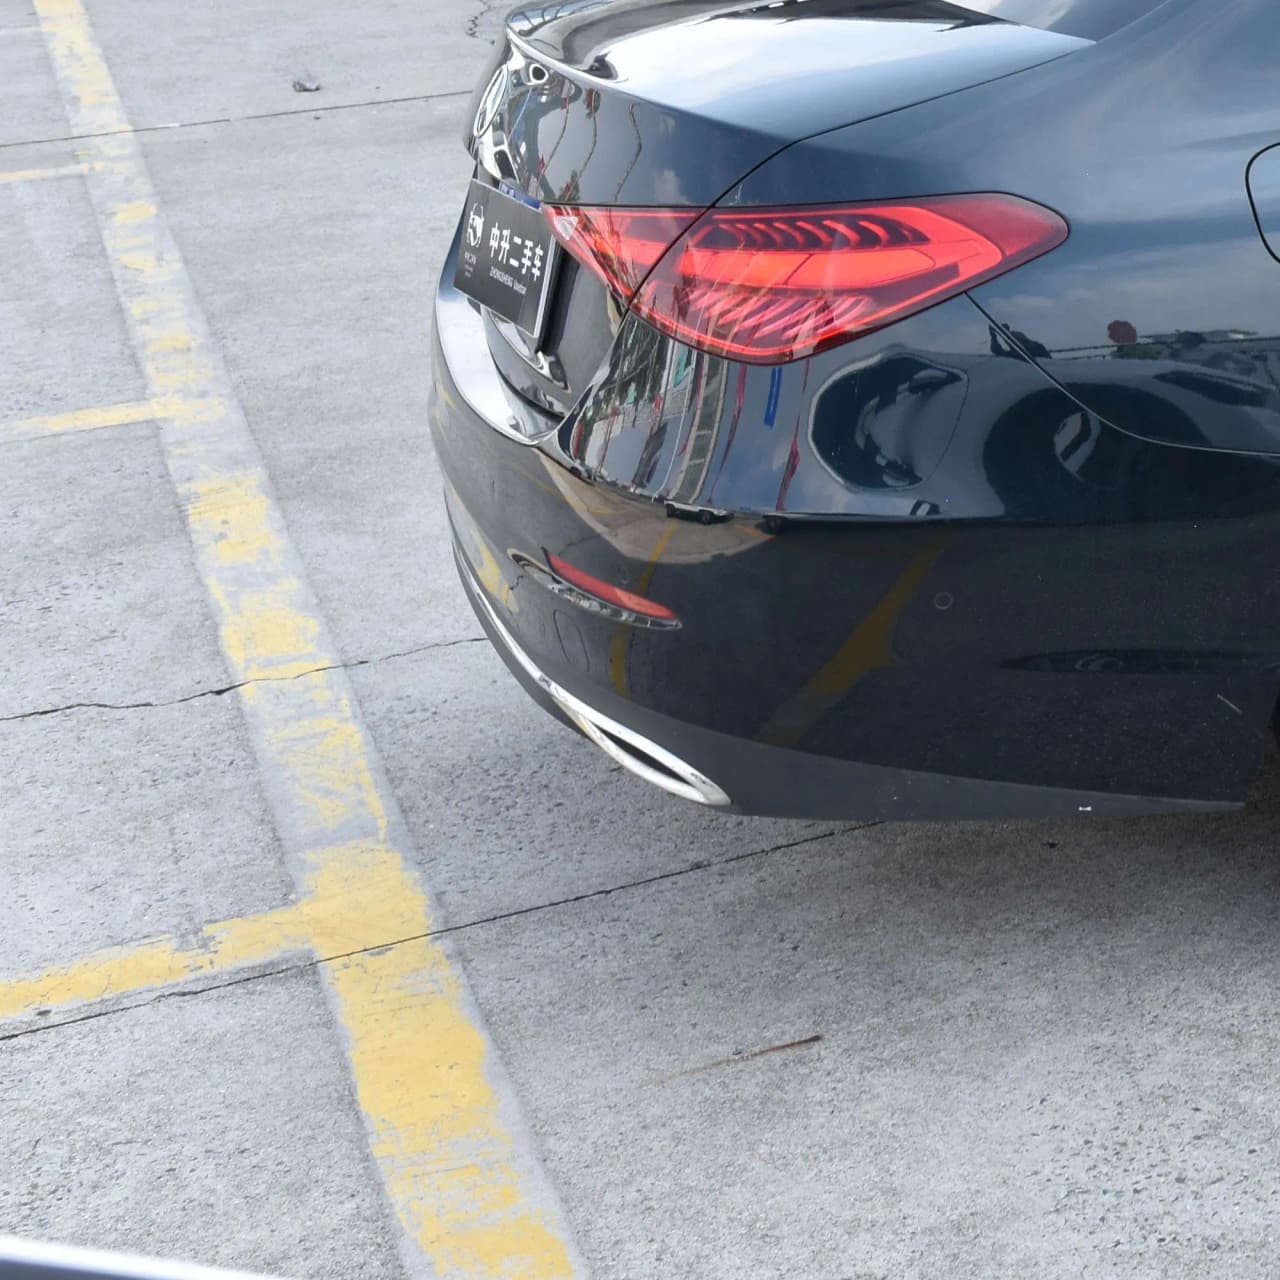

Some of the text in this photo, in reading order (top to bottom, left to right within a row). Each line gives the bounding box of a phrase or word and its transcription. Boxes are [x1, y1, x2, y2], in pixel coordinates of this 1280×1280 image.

[489, 222, 544, 282] 中升二手车
